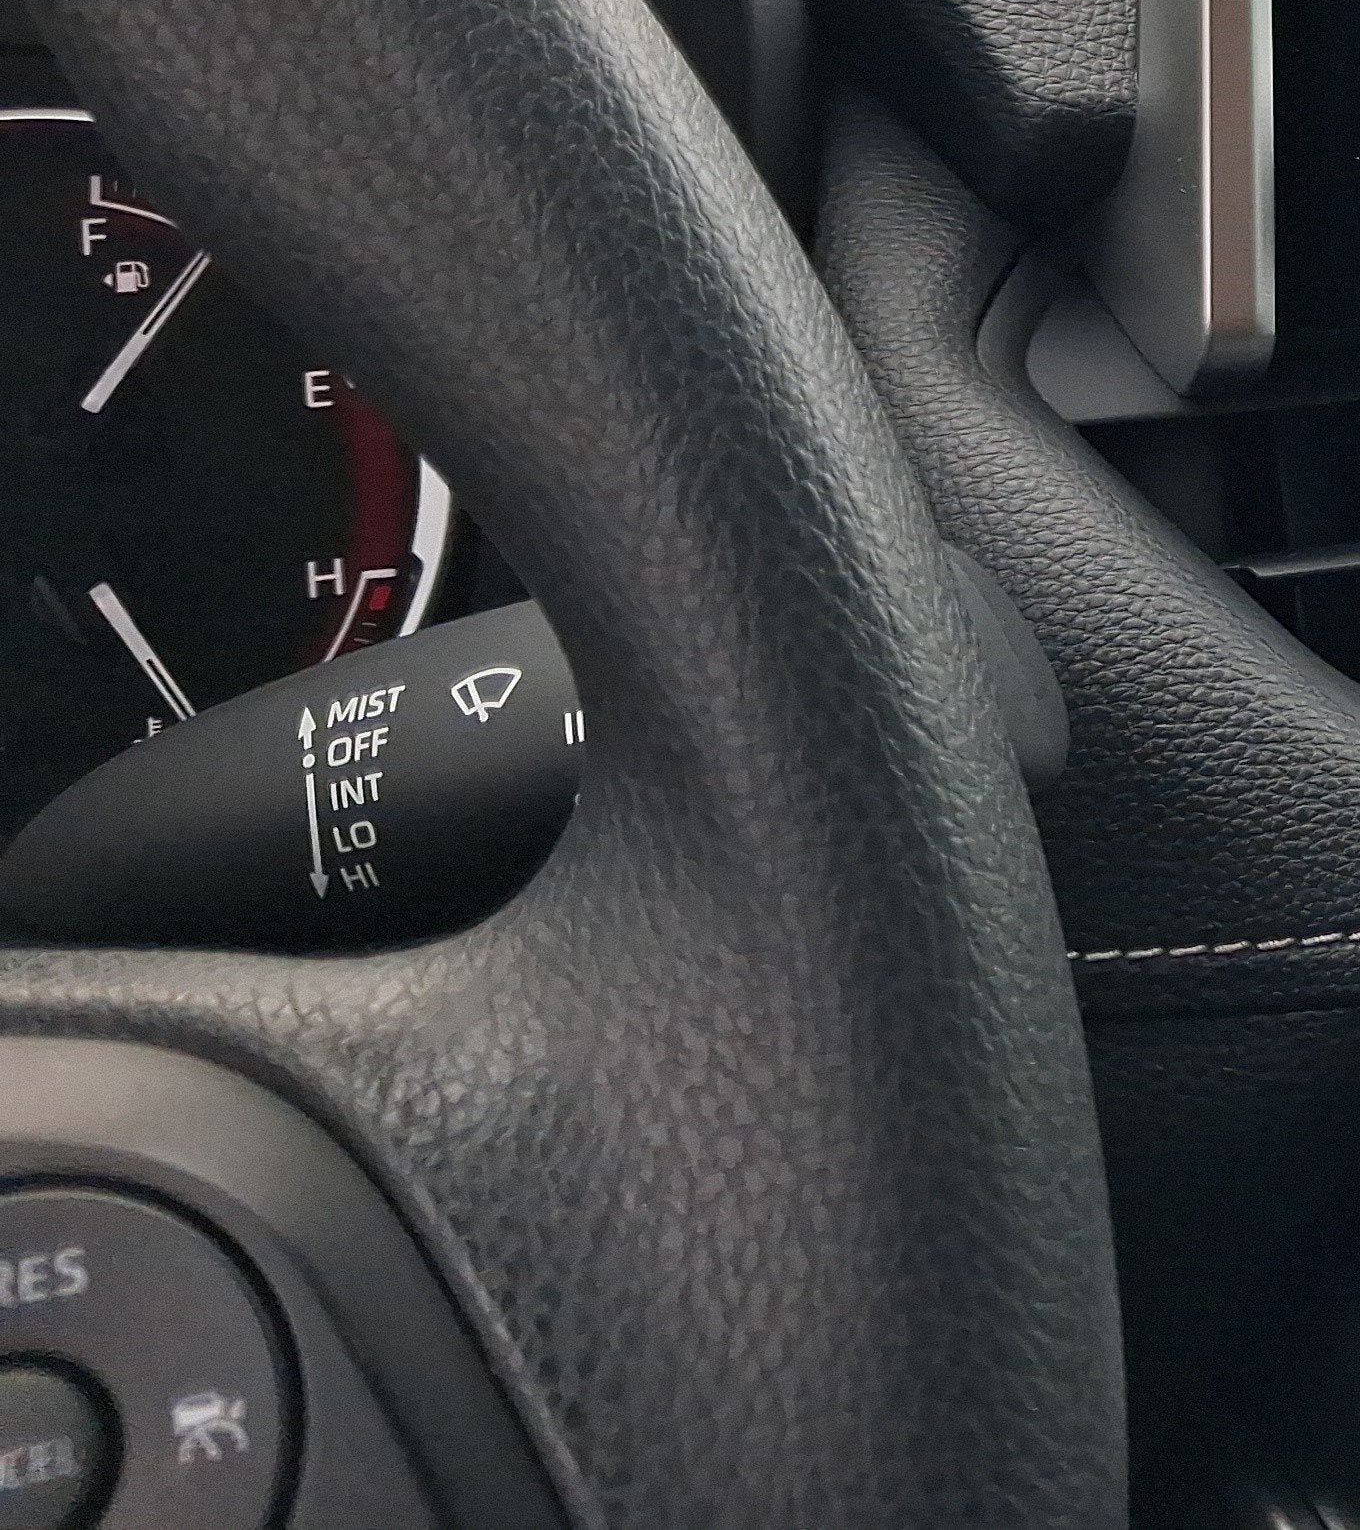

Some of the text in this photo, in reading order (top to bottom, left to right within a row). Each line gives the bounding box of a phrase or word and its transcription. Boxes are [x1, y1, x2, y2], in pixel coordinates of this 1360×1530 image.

[81, 217, 107, 257] F
[304, 369, 335, 409] E
[306, 557, 346, 600] H
[326, 684, 406, 729] MIST
[326, 725, 390, 768] OFF
[329, 771, 384, 812] INT
[331, 820, 377, 854] LO
[339, 861, 381, 893] HI
